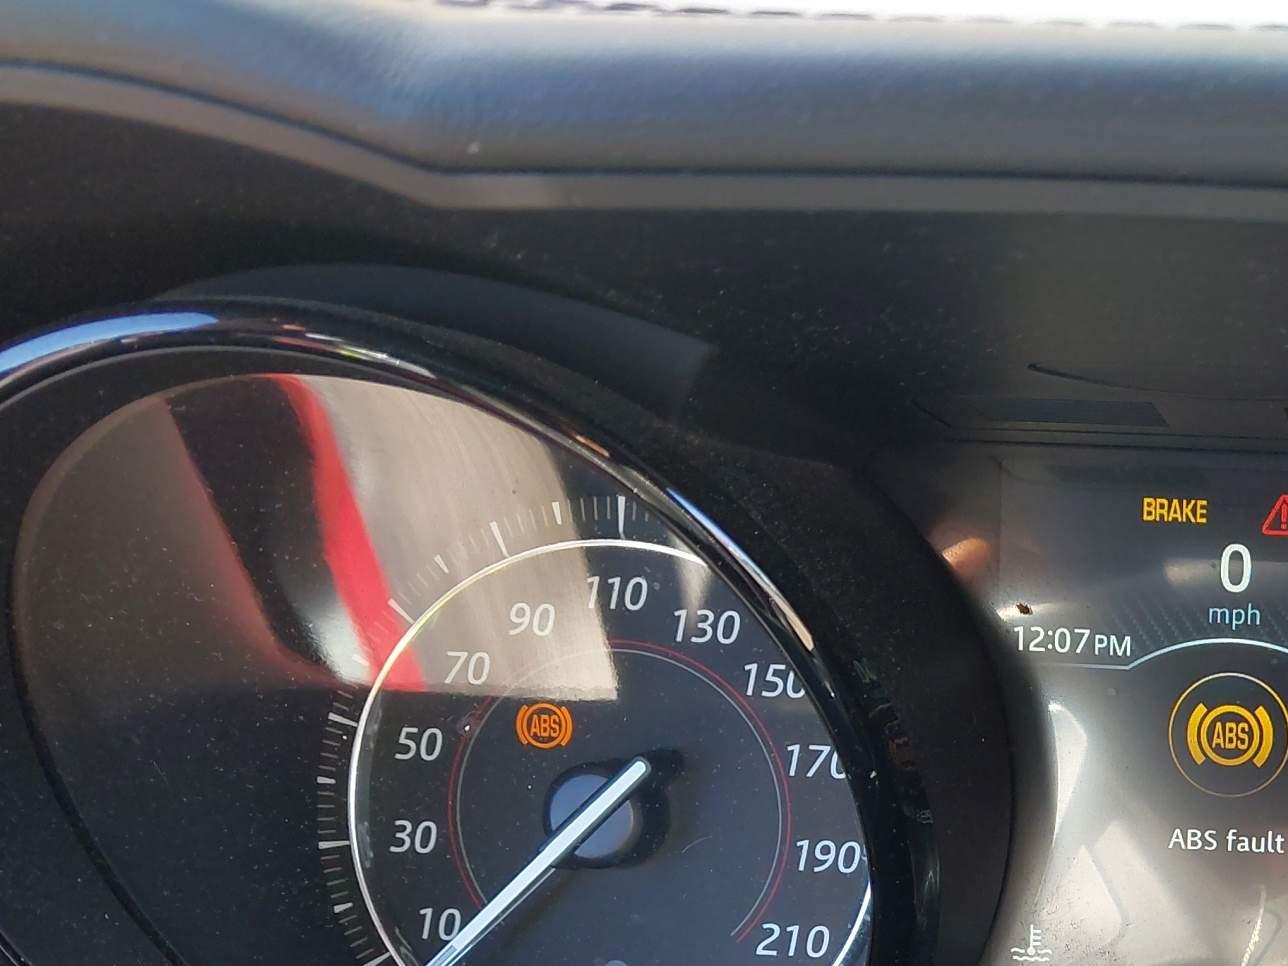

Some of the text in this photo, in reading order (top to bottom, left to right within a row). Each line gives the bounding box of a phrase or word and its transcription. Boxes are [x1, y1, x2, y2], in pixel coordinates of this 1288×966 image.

[1142, 497, 1208, 524] BRAKE
[1219, 543, 1253, 593] 0
[585, 575, 648, 612] 110
[509, 603, 556, 637] 90
[672, 608, 741, 646] 130
[1208, 603, 1261, 630] mph
[444, 651, 491, 686] 70
[530, 714, 561, 738] ABS
[1212, 722, 1250, 751] ABS
[394, 726, 442, 762] 50
[390, 819, 437, 855] 30
[1168, 827, 1286, 855] ABS fault
[795, 840, 861, 874] 190
[417, 906, 463, 942] 10
[756, 923, 831, 959] 210
